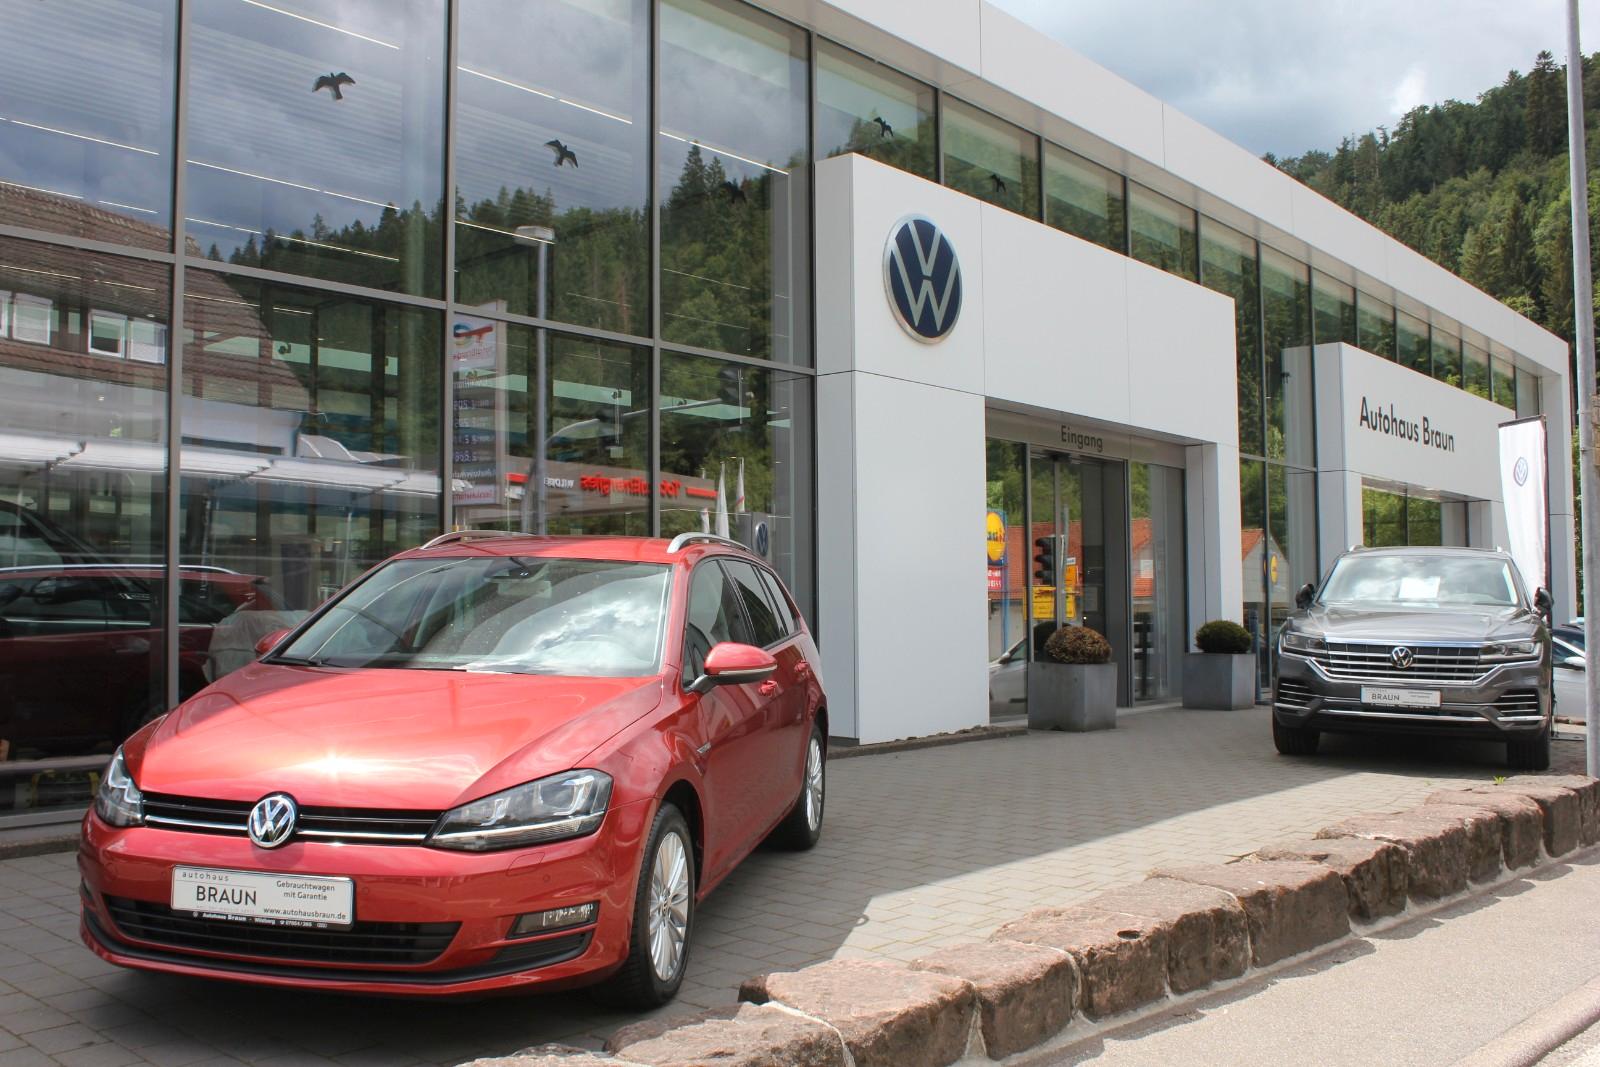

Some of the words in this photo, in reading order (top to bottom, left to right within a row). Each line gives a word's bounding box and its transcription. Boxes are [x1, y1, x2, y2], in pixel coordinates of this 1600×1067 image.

[1359, 396, 1419, 442] Autohaus
[1422, 415, 1455, 453] Braun
[1061, 424, 1103, 453] Eingang
[1371, 693, 1400, 701] BRAUN
[182, 871, 230, 881] autohaus
[276, 880, 335, 892] Gebrauchtwagen
[196, 885, 257, 905] BRAUN
[297, 892, 328, 900] Garantie
[263, 907, 347, 920] www.autohausbraun.de
